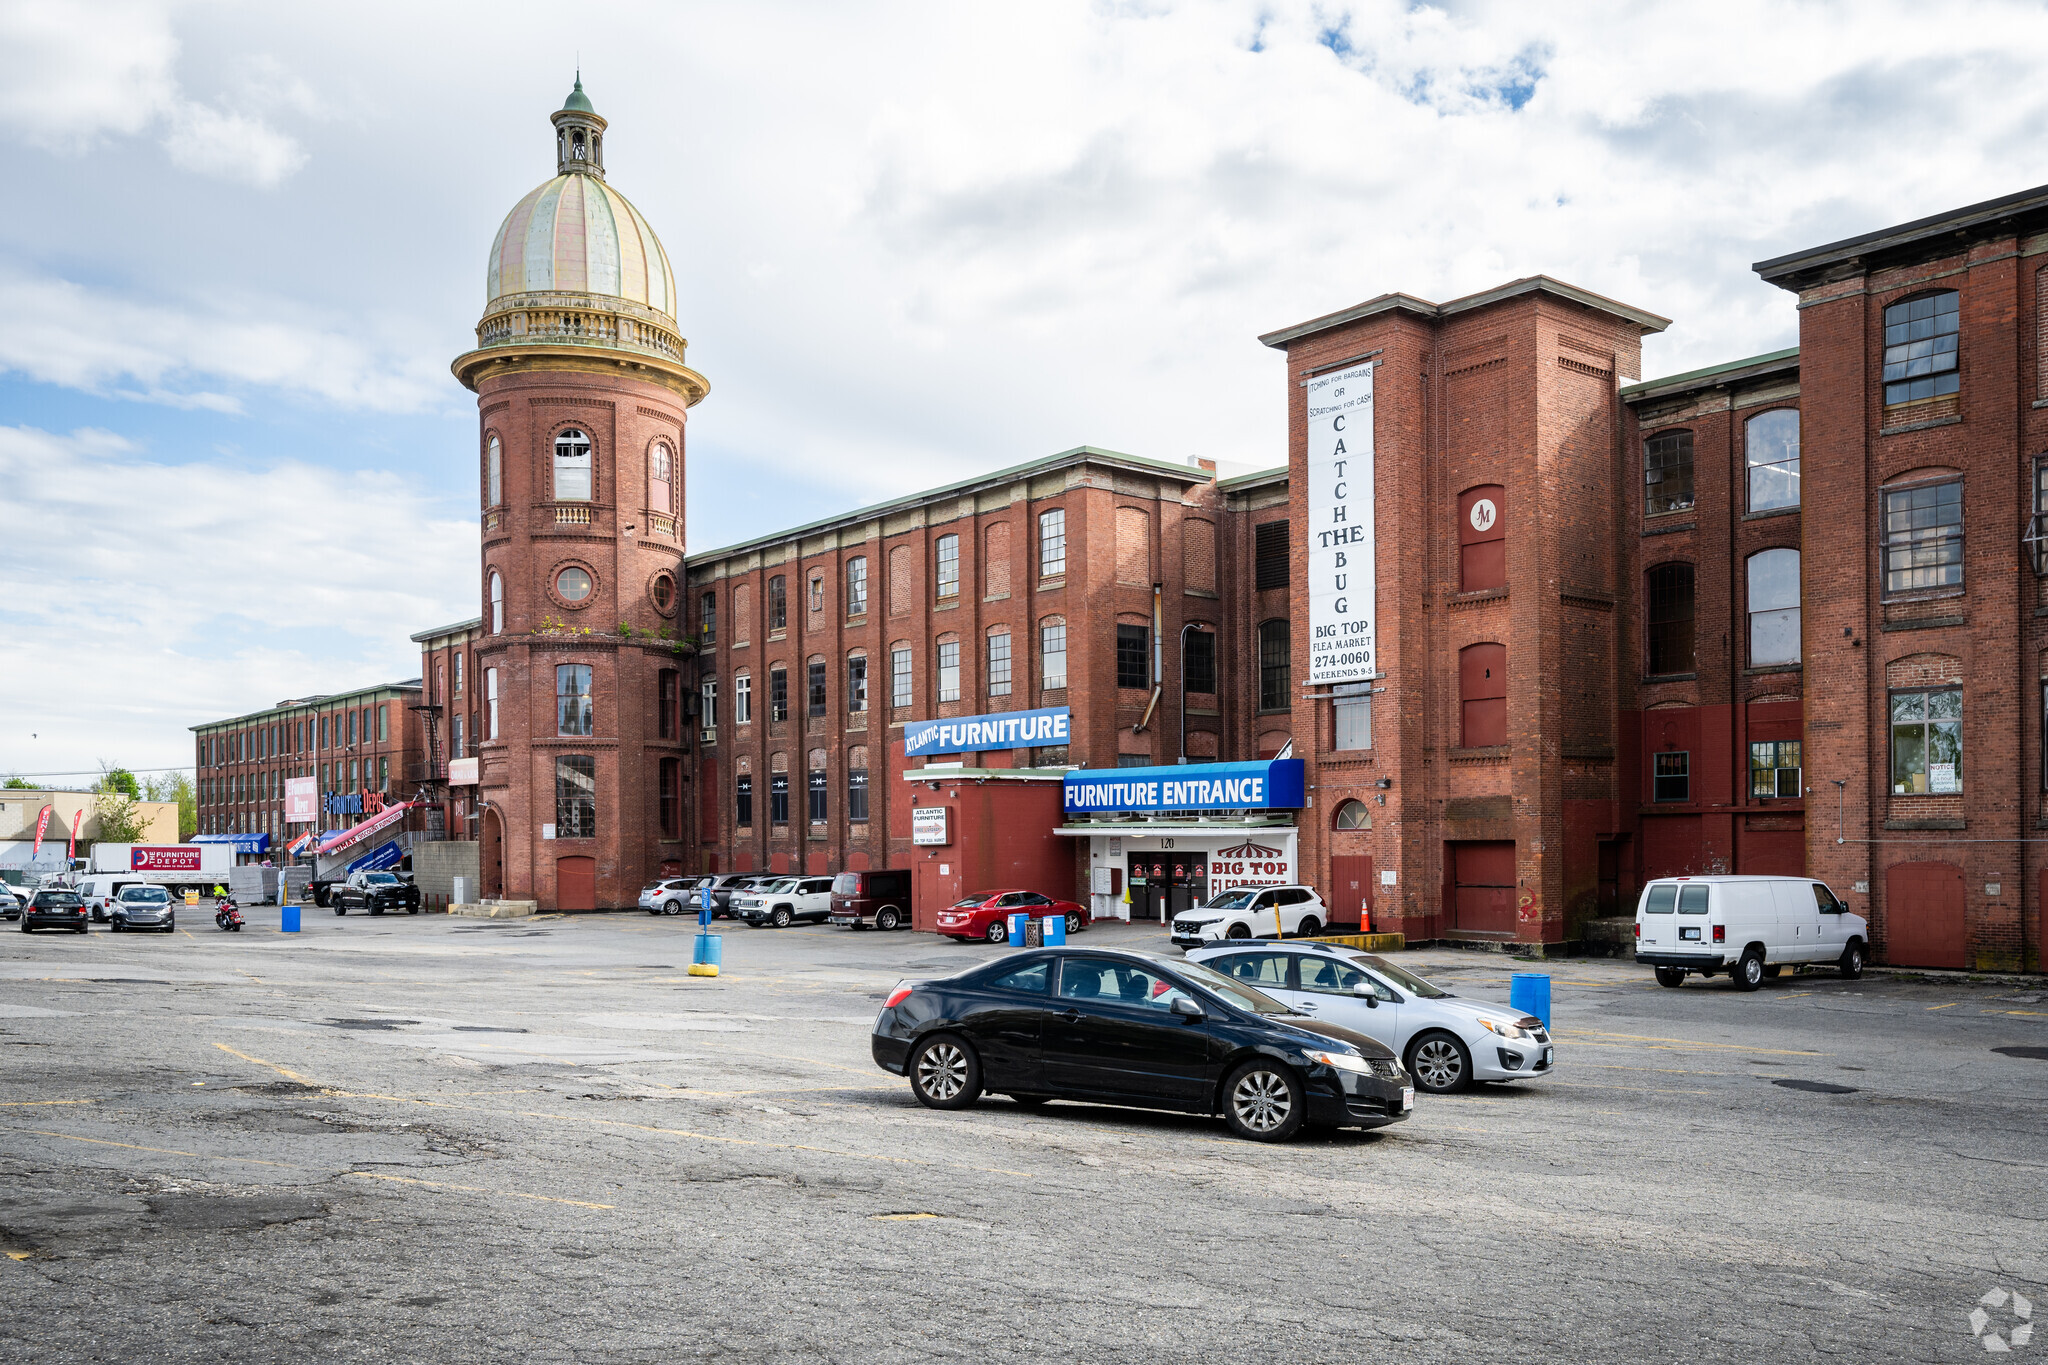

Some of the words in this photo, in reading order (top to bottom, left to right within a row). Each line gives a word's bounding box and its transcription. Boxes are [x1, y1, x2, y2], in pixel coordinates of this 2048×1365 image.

[1309, 378, 1330, 394] ITCHING
[1331, 375, 1342, 384] FOR
[1343, 367, 1372, 380] BARGAINS
[1334, 387, 1345, 398] OR
[1309, 404, 1342, 418] SCRATCHING
[1343, 400, 1355, 409] FOR
[1356, 392, 1372, 406] CASH
[1317, 524, 1365, 548] THE
[1315, 624, 1336, 638] BIG
[1340, 620, 1369, 635] TOP
[1313, 641, 1332, 652] FLEA
[1335, 636, 1372, 650] MARKET
[1315, 650, 1370, 668] 274-0060
[1313, 668, 1358, 680] WEEKENDS
[906, 724, 939, 754] ATLANTIC
[939, 713, 1068, 748] FURNITURE
[329, 790, 363, 814] FURNITURE
[363, 788, 384, 813] DEPOT
[1065, 782, 1158, 808] FURNITURE
[1162, 778, 1263, 805] ENTRANCE
[335, 836, 358, 852] OMAR
[1160, 838, 1175, 849] 120
[1211, 862, 1245, 875] BIG
[1249, 862, 1288, 875] TOP
